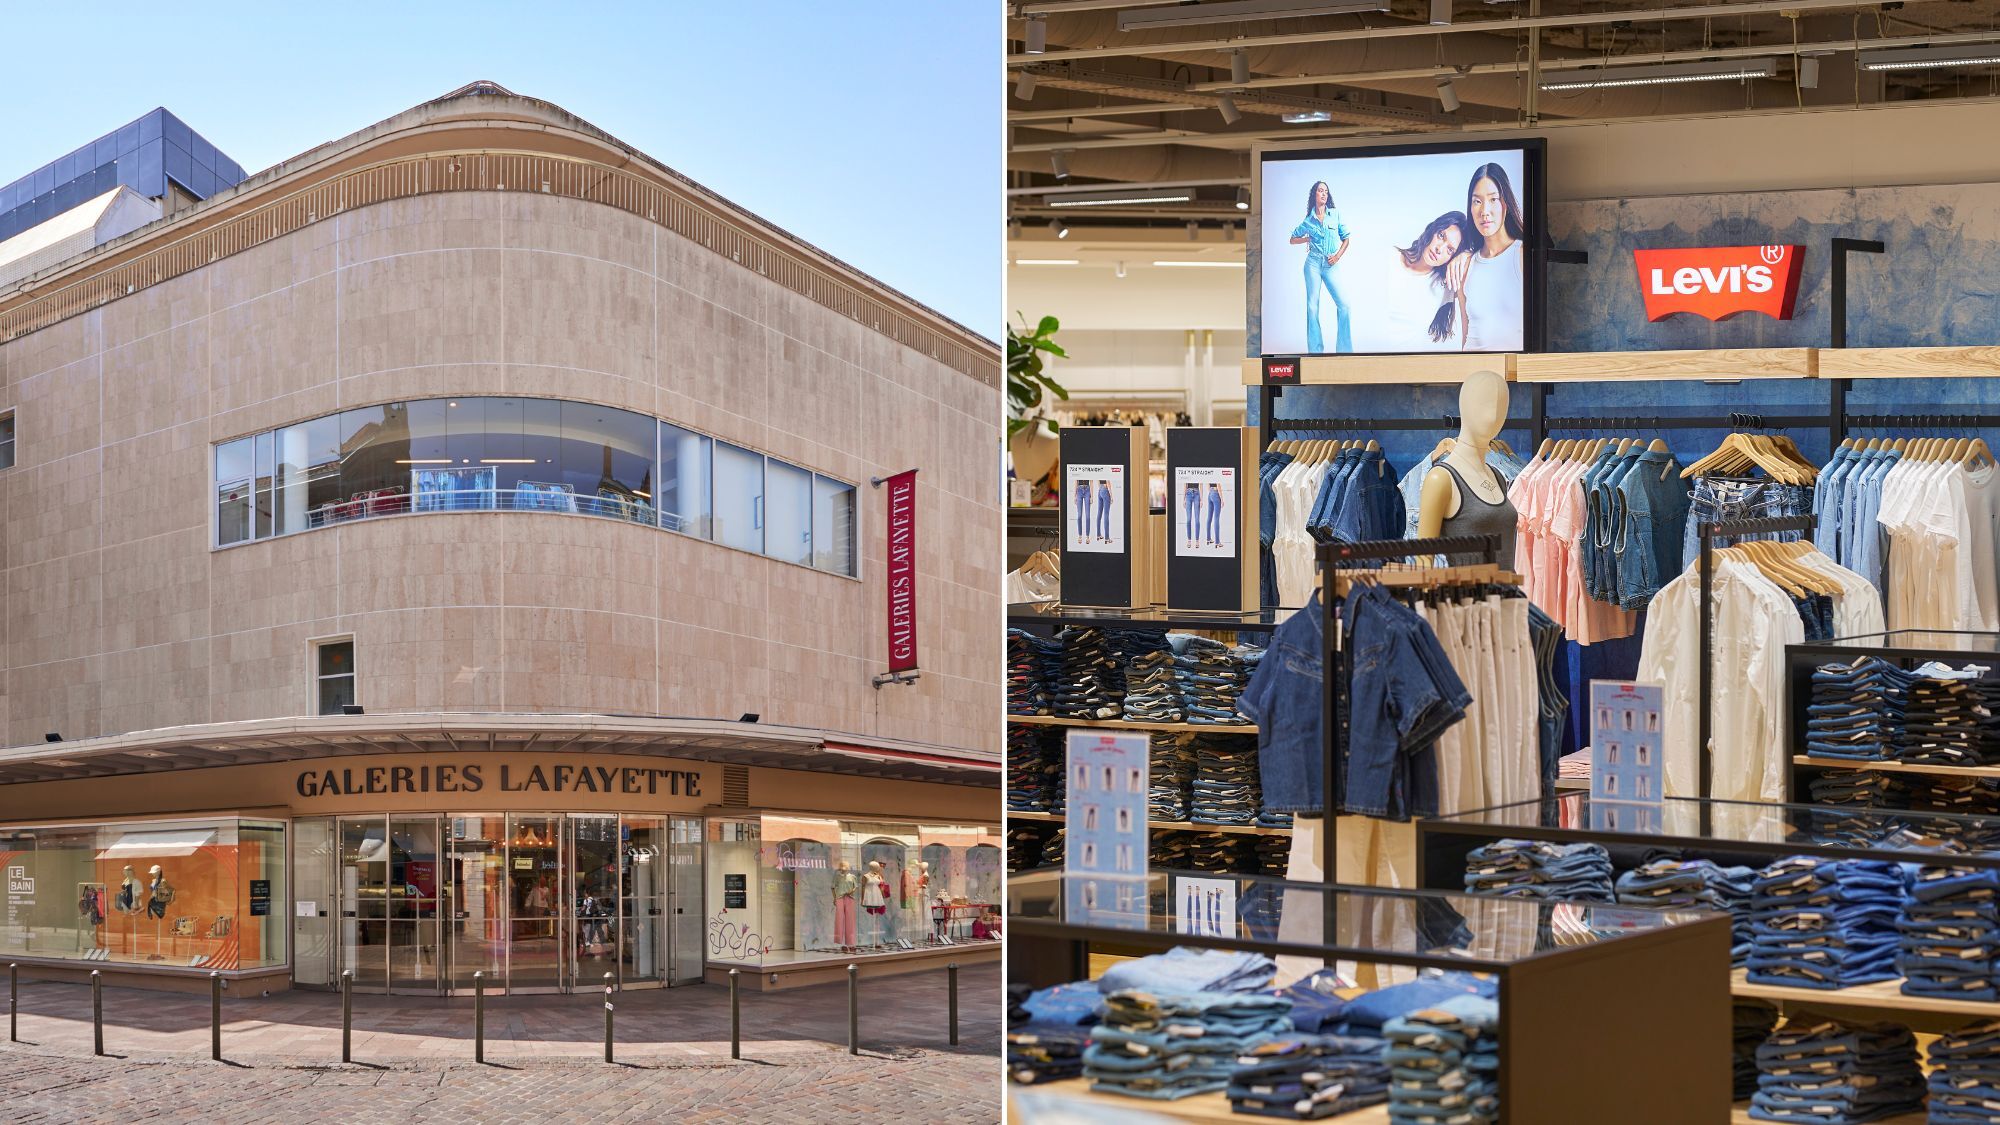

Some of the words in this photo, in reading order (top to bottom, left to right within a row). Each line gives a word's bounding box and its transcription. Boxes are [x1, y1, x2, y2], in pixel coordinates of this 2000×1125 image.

[892, 482, 910, 574] LAFAYETTE
[893, 576, 910, 660] GALERIES
[296, 765, 484, 798] GALERIES
[500, 764, 702, 797] LAFAYETTE
[11, 869, 22, 878] LE
[11, 881, 31, 891] BAIN
